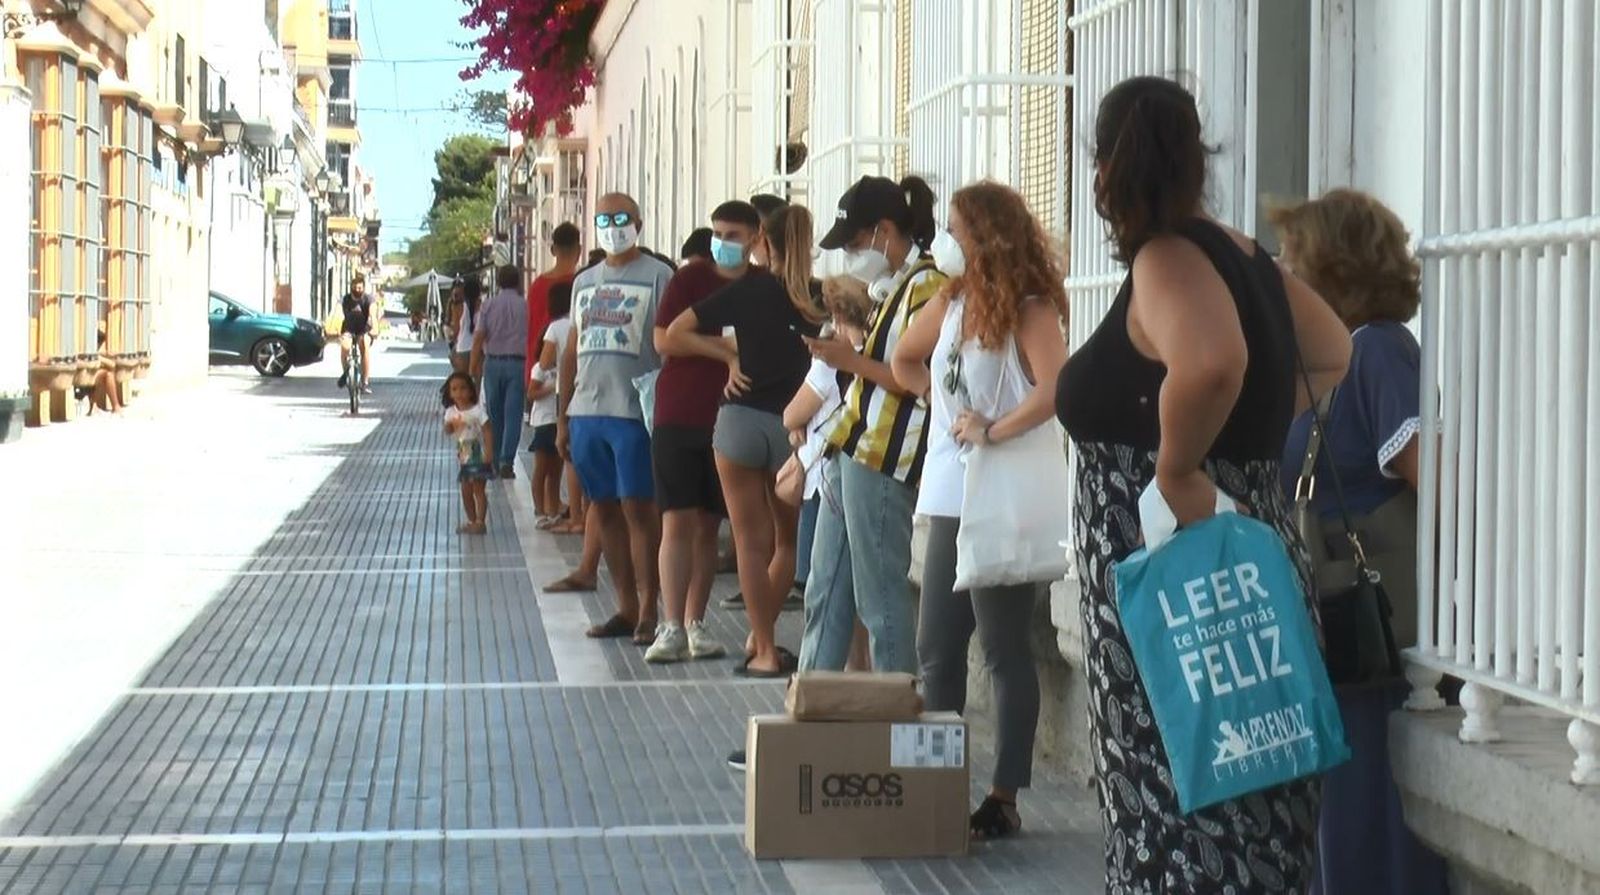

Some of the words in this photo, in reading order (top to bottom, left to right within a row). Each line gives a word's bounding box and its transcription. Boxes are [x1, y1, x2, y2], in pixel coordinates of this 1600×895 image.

[1157, 561, 1269, 629] LEER
[1173, 634, 1194, 650] te
[1195, 619, 1237, 643] hace
[1240, 603, 1276, 629] más
[1178, 624, 1293, 703] FELIZ
[822, 772, 903, 798] asos
